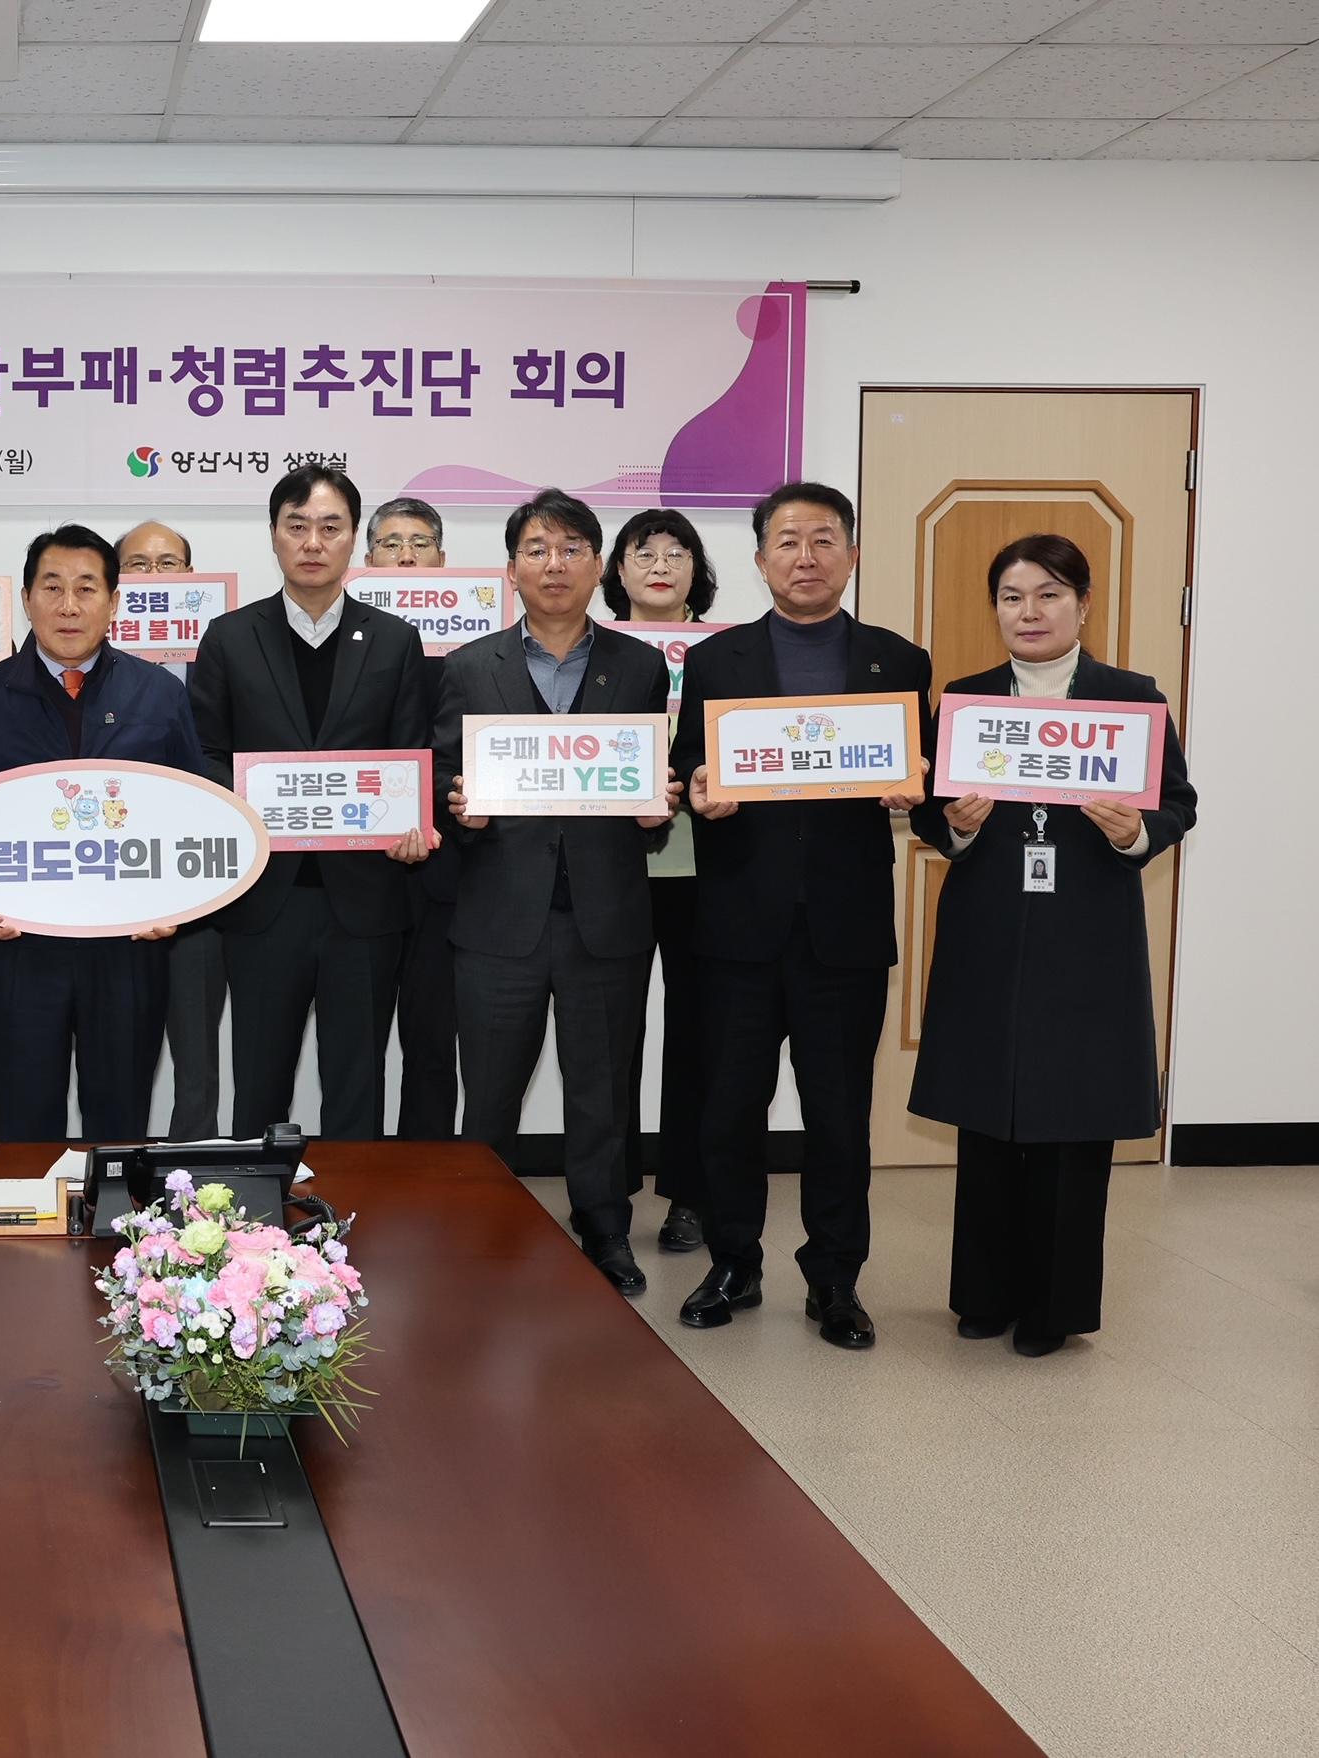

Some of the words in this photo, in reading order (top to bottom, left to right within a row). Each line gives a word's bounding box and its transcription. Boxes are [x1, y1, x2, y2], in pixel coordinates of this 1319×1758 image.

[510, 348, 625, 409] 회의
[171, 451, 269, 474] 양산시청
[126, 591, 169, 614] 청렴
[396, 590, 458, 608] ZERO
[148, 619, 199, 641] 불가!
[978, 718, 1030, 746] 갑질
[1038, 720, 1125, 750] OUT
[489, 736, 540, 761] 부패
[548, 735, 601, 761] NO
[734, 748, 784, 773] 갑질
[791, 751, 833, 771] 말고
[840, 744, 893, 769] 배려
[516, 767, 565, 792] 신뢰
[573, 766, 641, 792] YES
[1018, 752, 1072, 780] 존중
[1079, 755, 1118, 783] IN
[276, 772, 348, 797] 갑질은
[355, 770, 382, 796] 독
[263, 806, 334, 831] 존중은
[341, 803, 370, 830] 약
[175, 836, 239, 880] 해!
